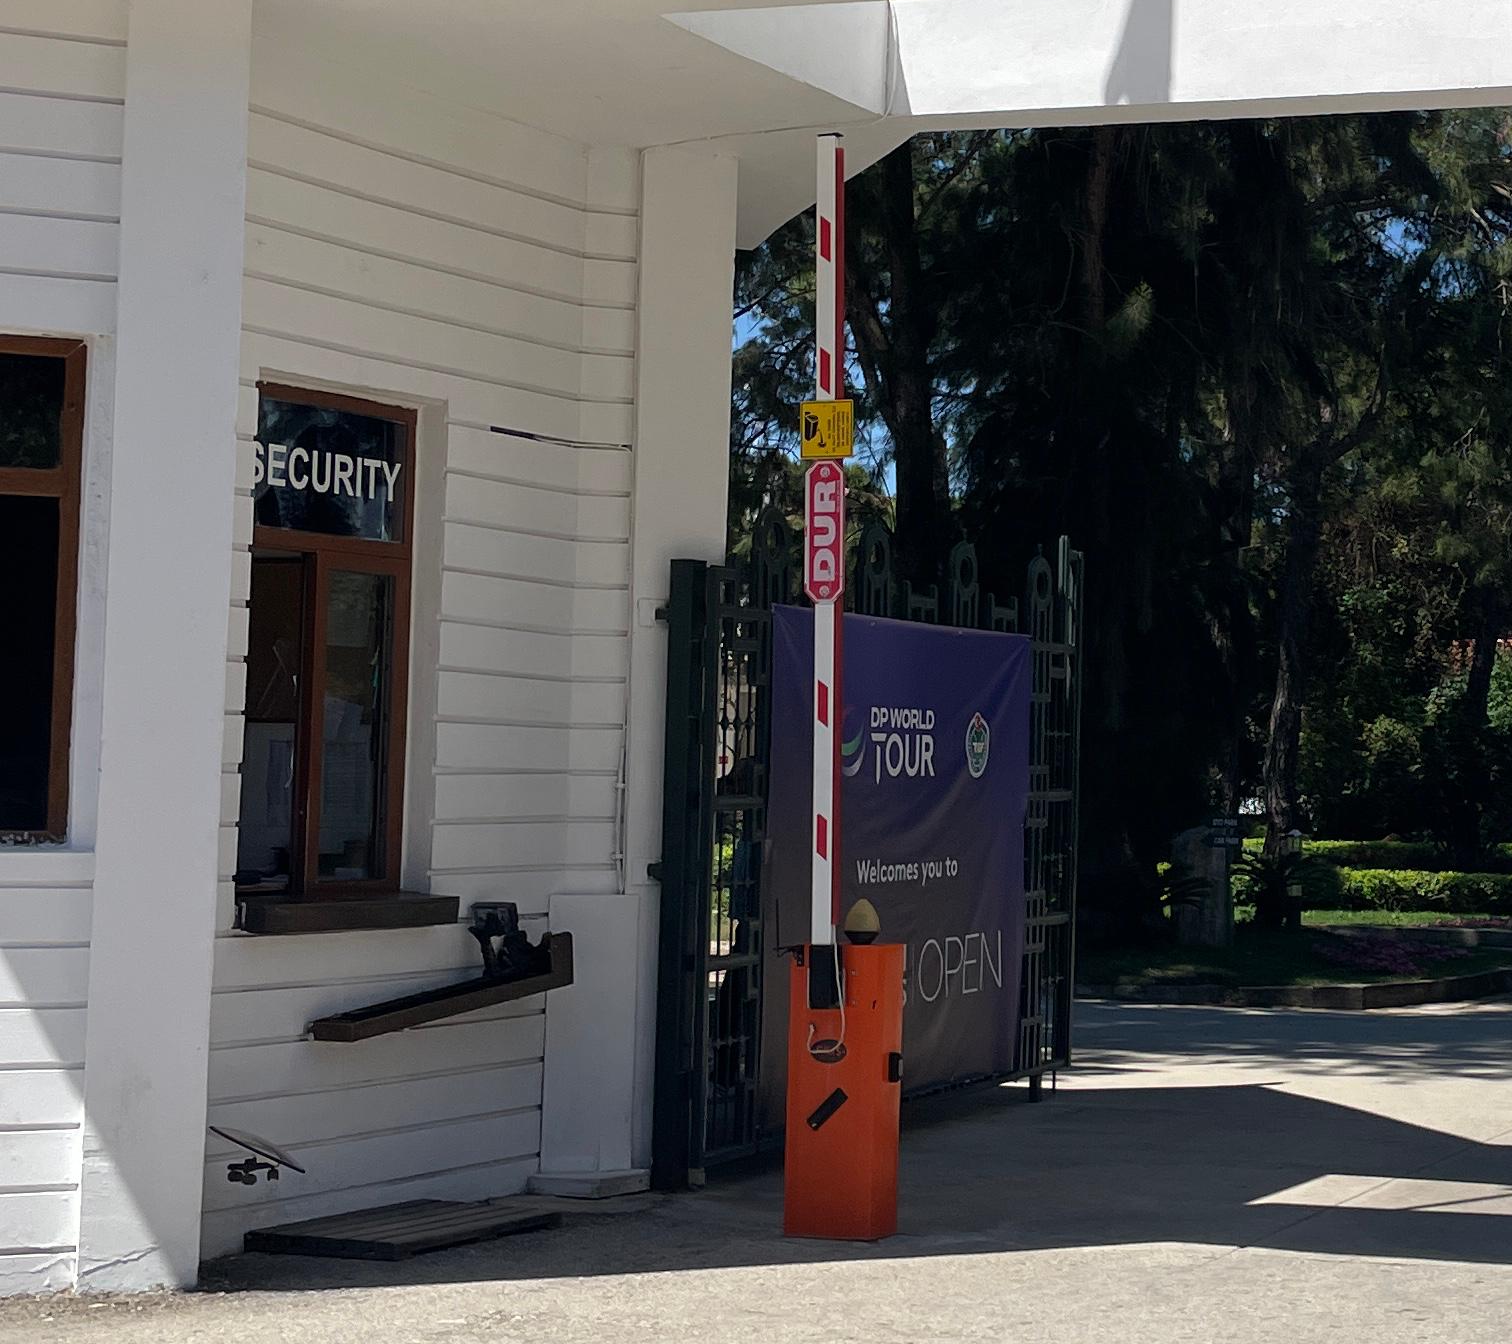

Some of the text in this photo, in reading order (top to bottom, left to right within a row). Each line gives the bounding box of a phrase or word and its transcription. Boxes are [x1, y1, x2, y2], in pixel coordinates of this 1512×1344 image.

[253, 440, 401, 502] SECURITY
[813, 480, 836, 582] DUR
[870, 706, 935, 730] DP WORLD
[870, 732, 936, 785] TOUR
[856, 856, 958, 887] Welcomes you to
[918, 929, 1003, 1002] OPEN
